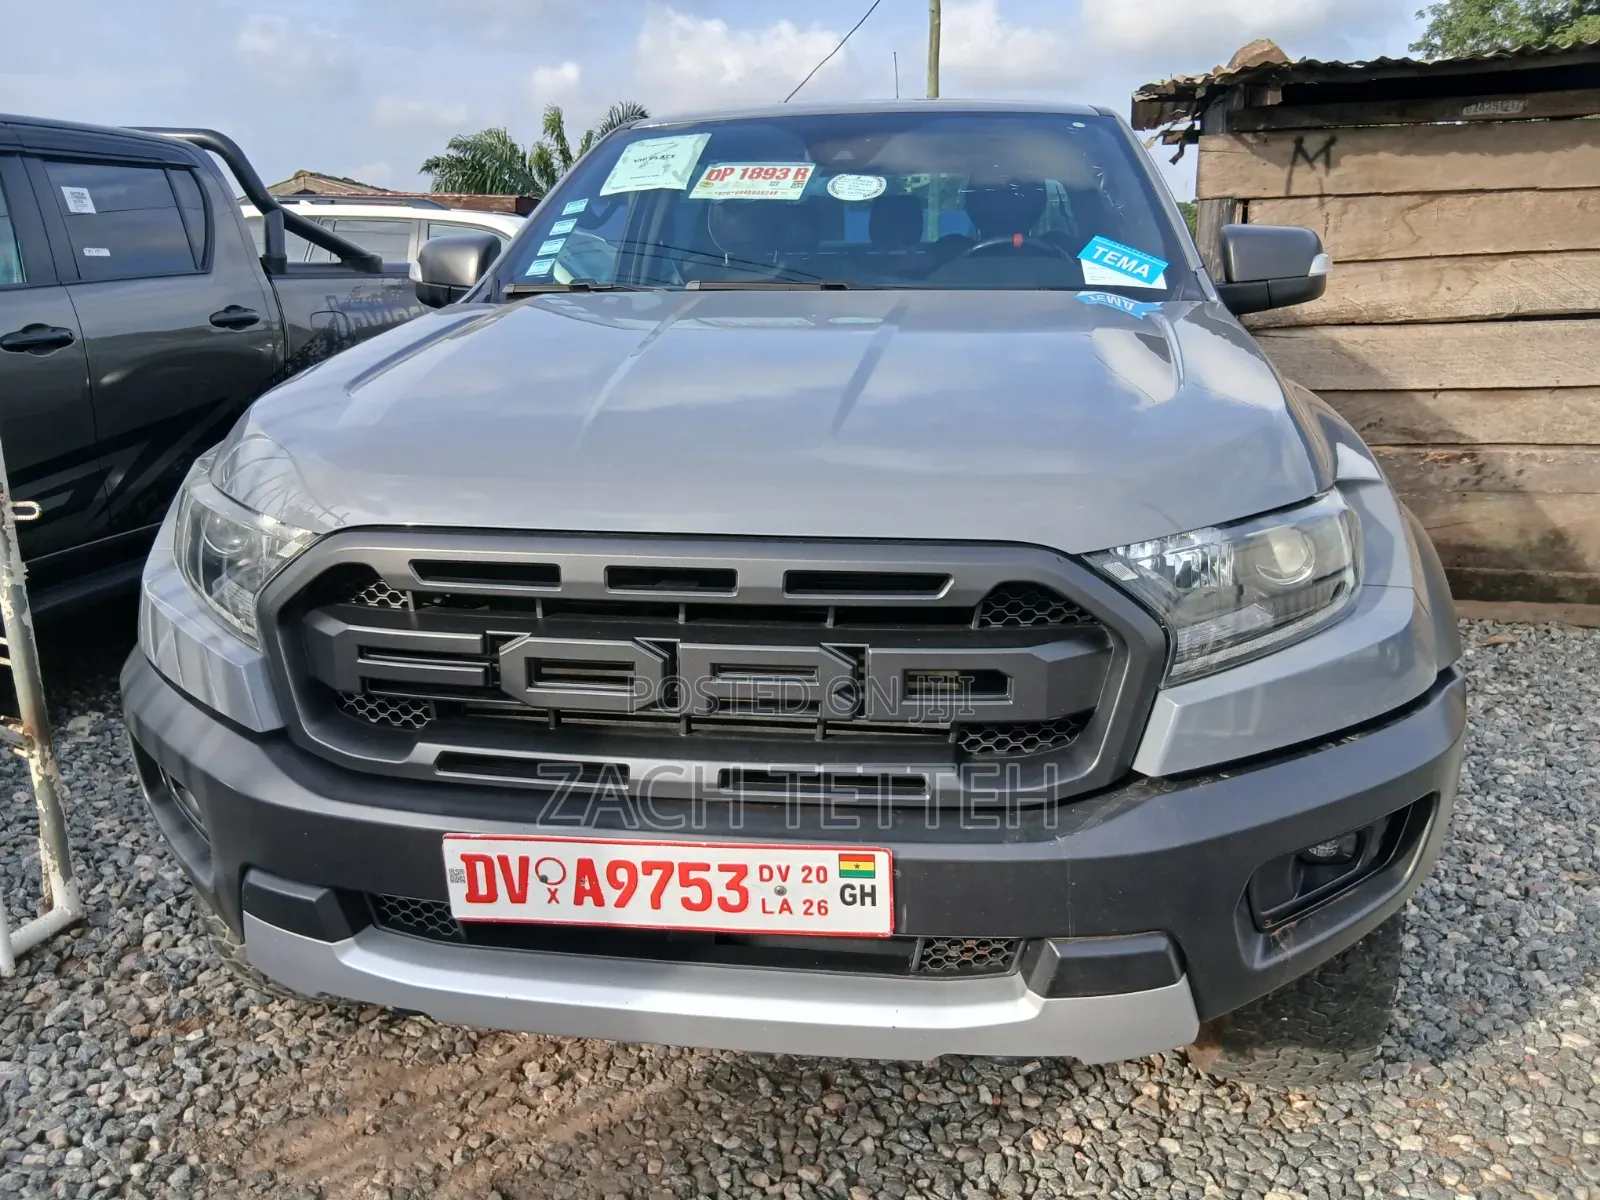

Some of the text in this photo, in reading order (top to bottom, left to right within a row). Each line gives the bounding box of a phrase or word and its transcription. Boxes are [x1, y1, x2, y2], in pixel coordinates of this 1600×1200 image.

[740, 167, 791, 181] 1893
[792, 167, 810, 181] R
[1092, 245, 1150, 279] TEMA
[304, 620, 1108, 723] FORD
[460, 853, 530, 904] DV
[573, 859, 749, 913] A9753
[758, 863, 828, 884] DV 20
[761, 897, 829, 917] LA 26
[839, 882, 877, 907] GH
